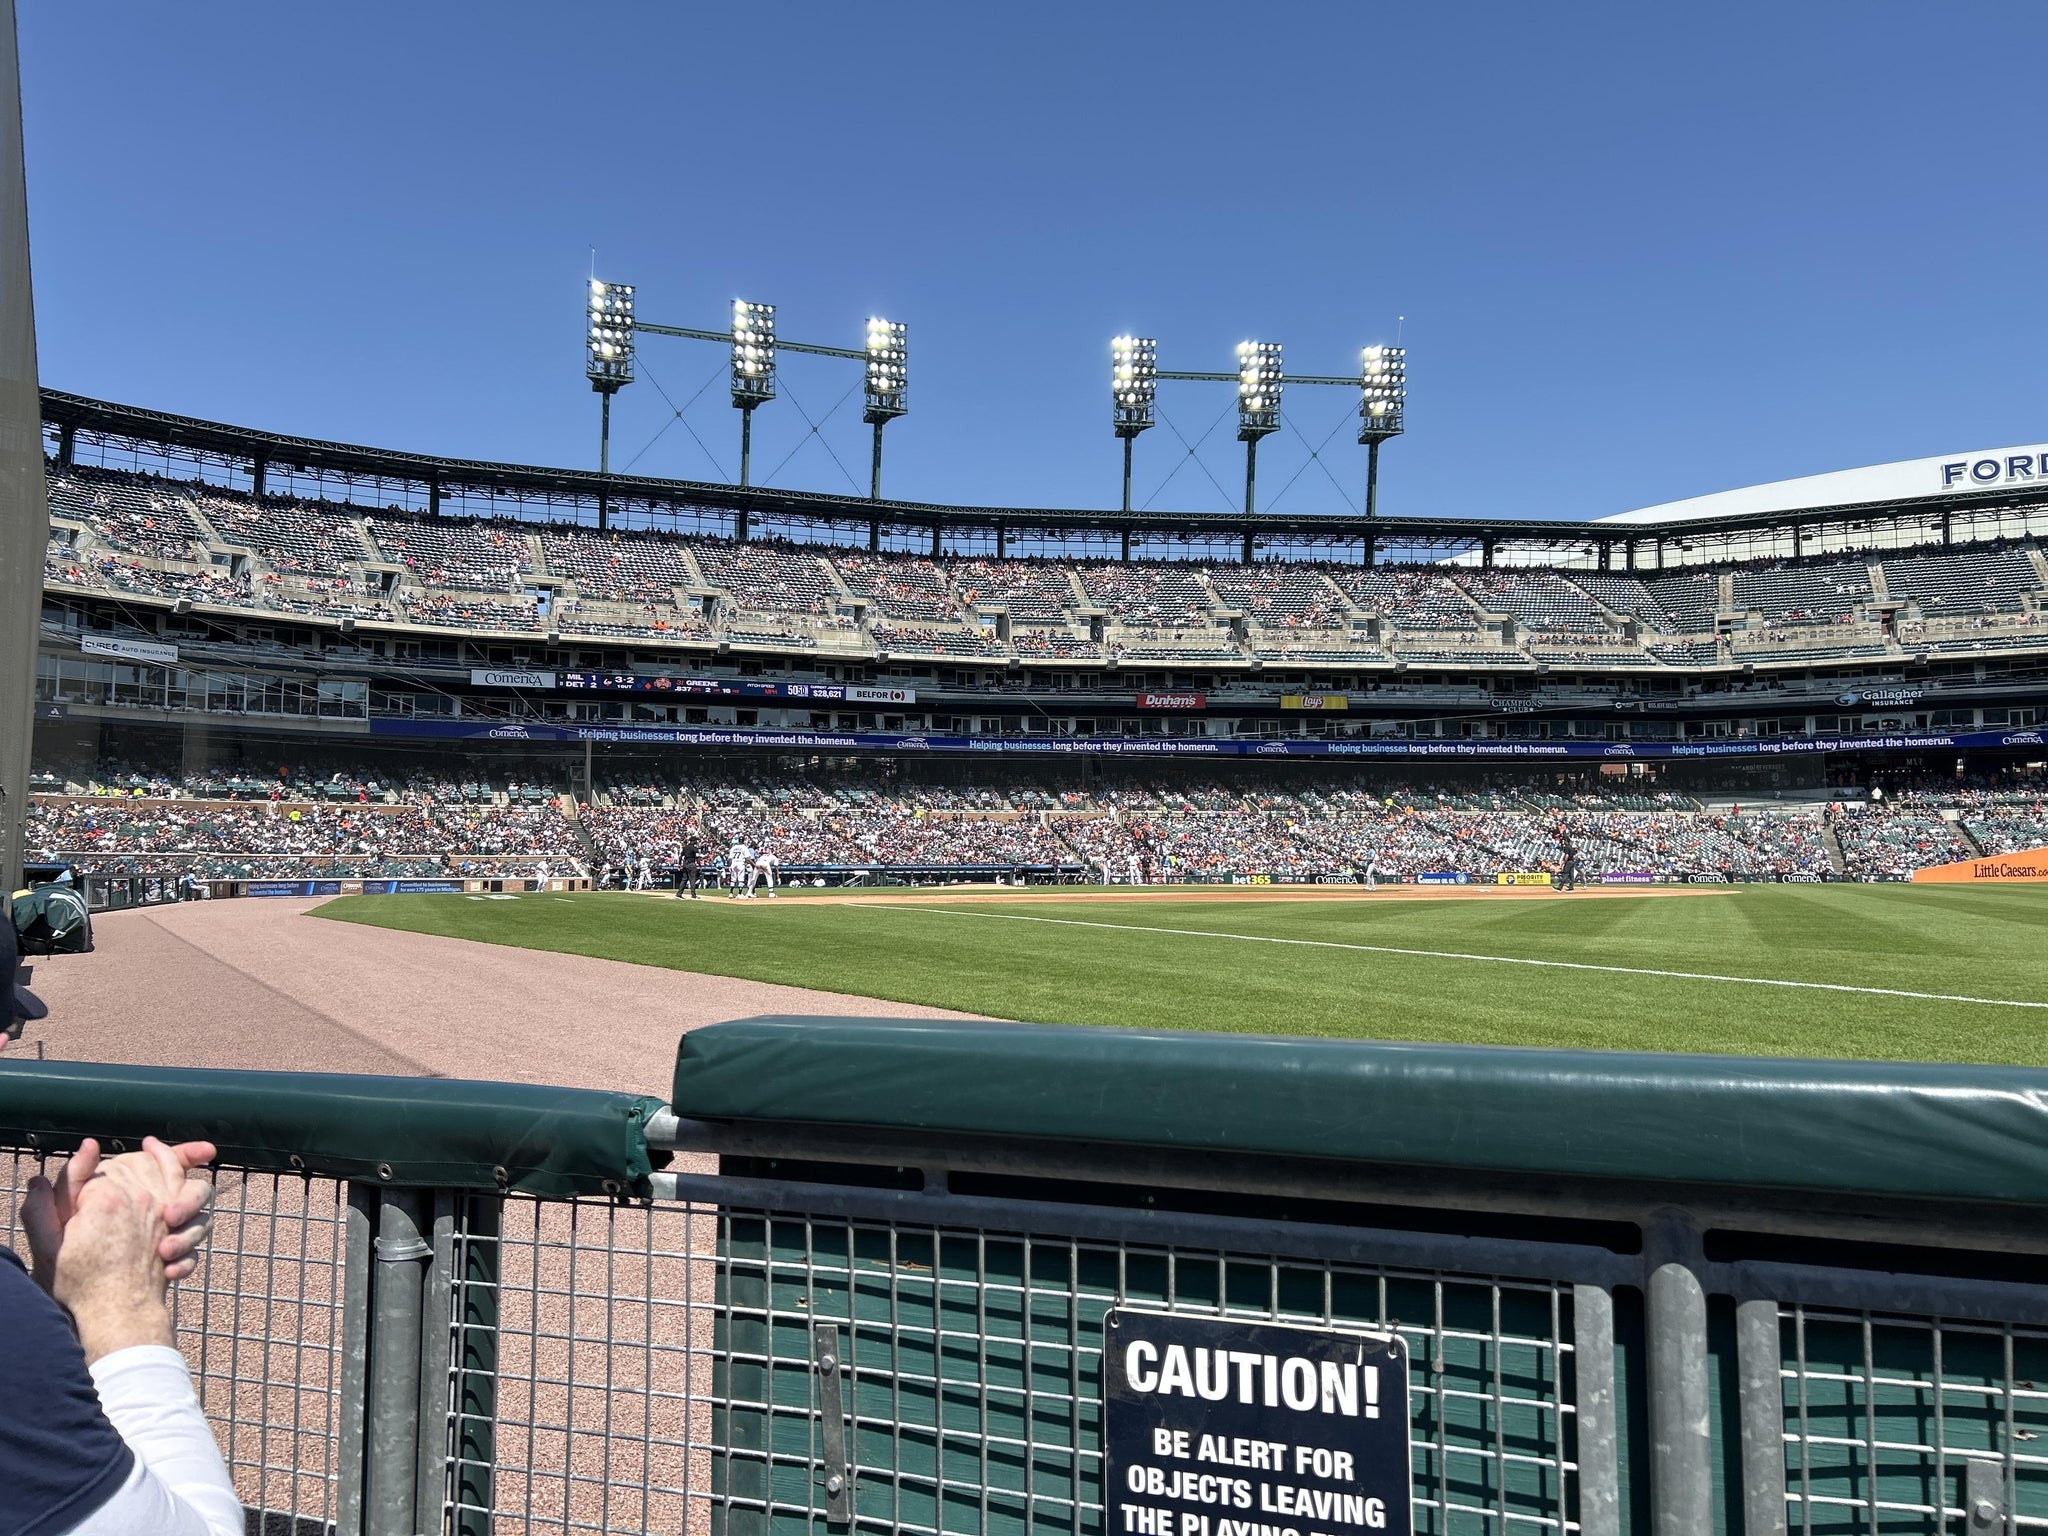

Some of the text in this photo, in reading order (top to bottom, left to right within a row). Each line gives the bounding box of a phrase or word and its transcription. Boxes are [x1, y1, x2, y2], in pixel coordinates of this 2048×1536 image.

[856, 691, 888, 699] BELFOR
[1146, 695, 1196, 705] Dunham's
[1862, 689, 1923, 701] Gallagher
[578, 728, 857, 745] Helping businesses long before they invented the homerun.
[969, 740, 1003, 751] Helping
[1004, 741, 1050, 750] businesses
[1053, 742, 1071, 752] long
[1073, 742, 1101, 750] before
[1103, 742, 1122, 752] they
[1124, 743, 1160, 751] invented
[1178, 743, 1218, 751] homerun.
[1328, 743, 1568, 754] Helping businesses long before they invented the homerun.
[1672, 737, 1954, 755] Helping businesses long before they invented the homerun.
[1974, 863, 2048, 877] Little Caesars.co
[1232, 875, 1271, 884] bet365
[1602, 875, 1624, 884] planet
[1126, 1340, 1380, 1418] CAUTION!
[1154, 1428, 1354, 1481] BE ALERT FOR
[1128, 1465, 1386, 1528] OBJECTS LEAVING
[1121, 1504, 1300, 1536] THE PLAY
